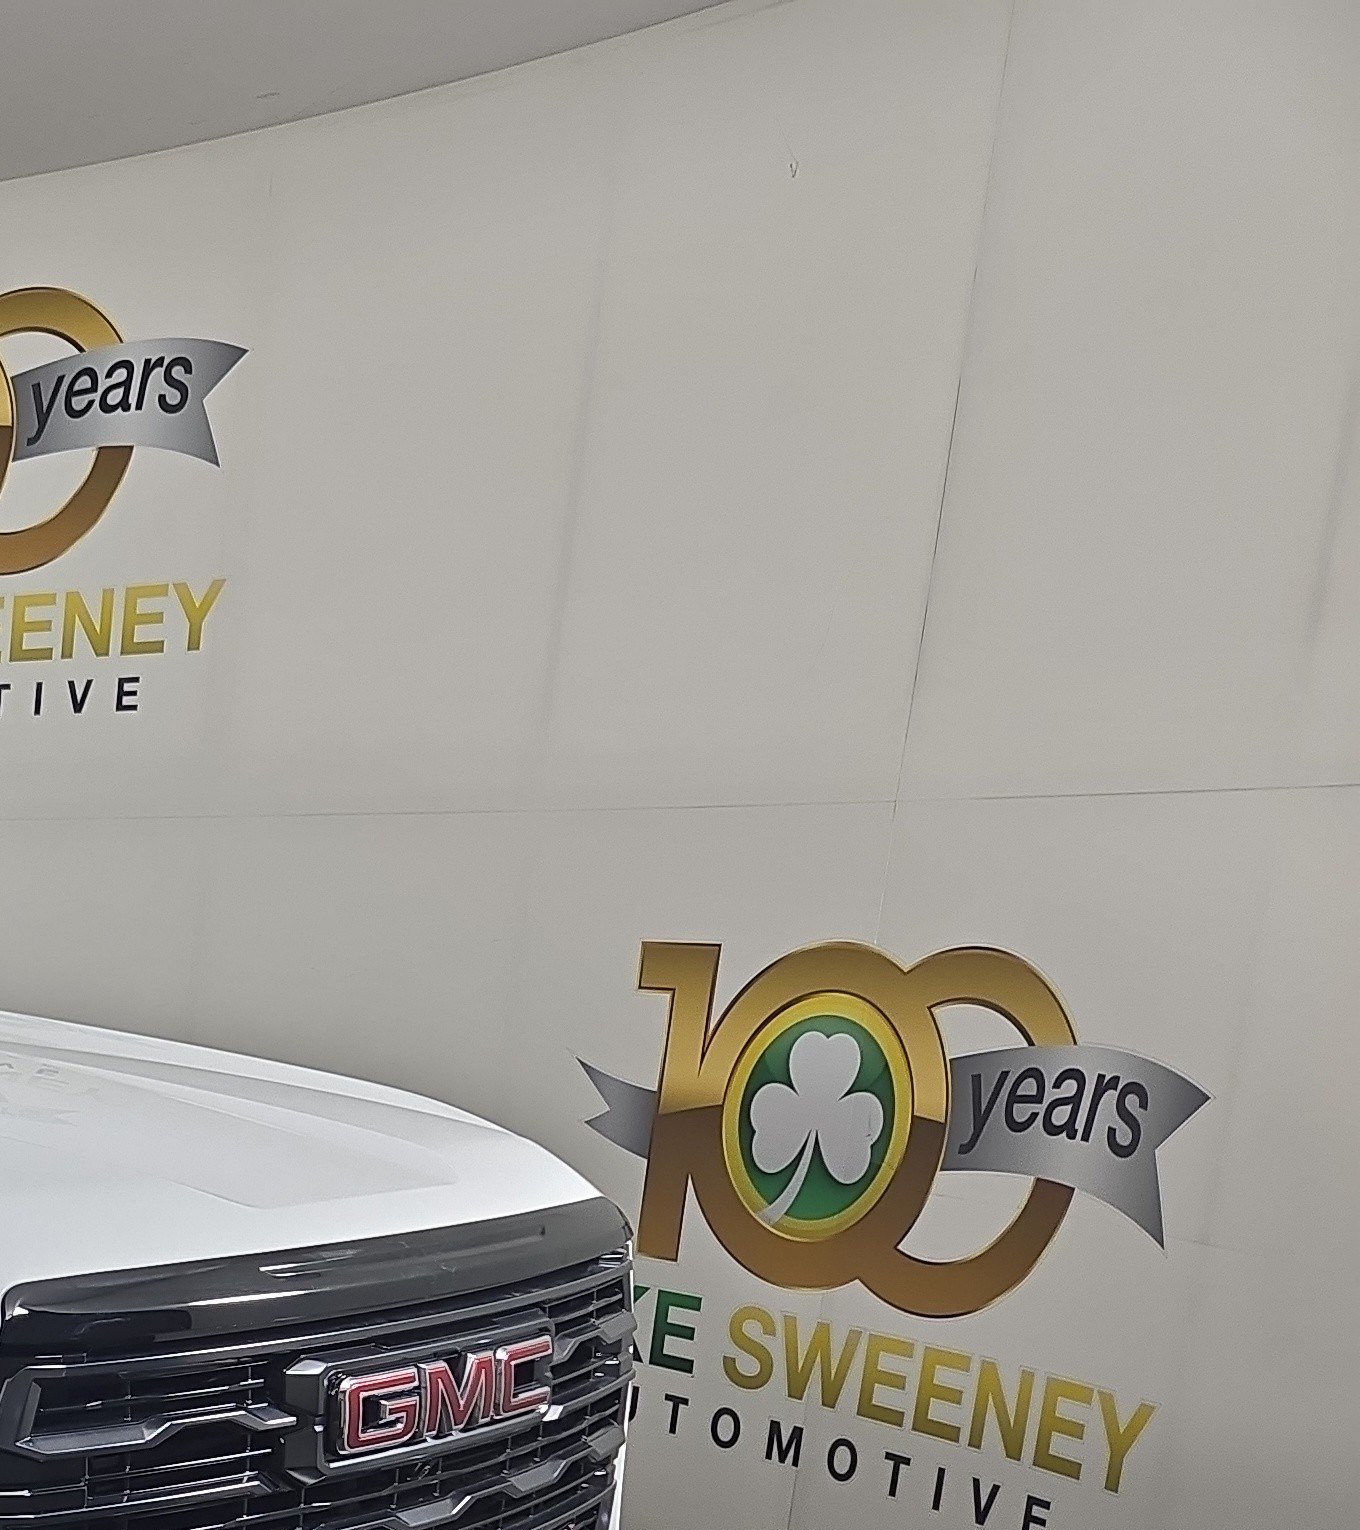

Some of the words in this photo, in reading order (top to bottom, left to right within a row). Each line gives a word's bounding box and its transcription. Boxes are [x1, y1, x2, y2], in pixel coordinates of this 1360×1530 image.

[26, 353, 194, 447] years
[636, 940, 1079, 1319] 100
[958, 1063, 1149, 1160] years
[338, 1334, 554, 1456] GMC
[722, 1305, 1156, 1494] SWEENEY
